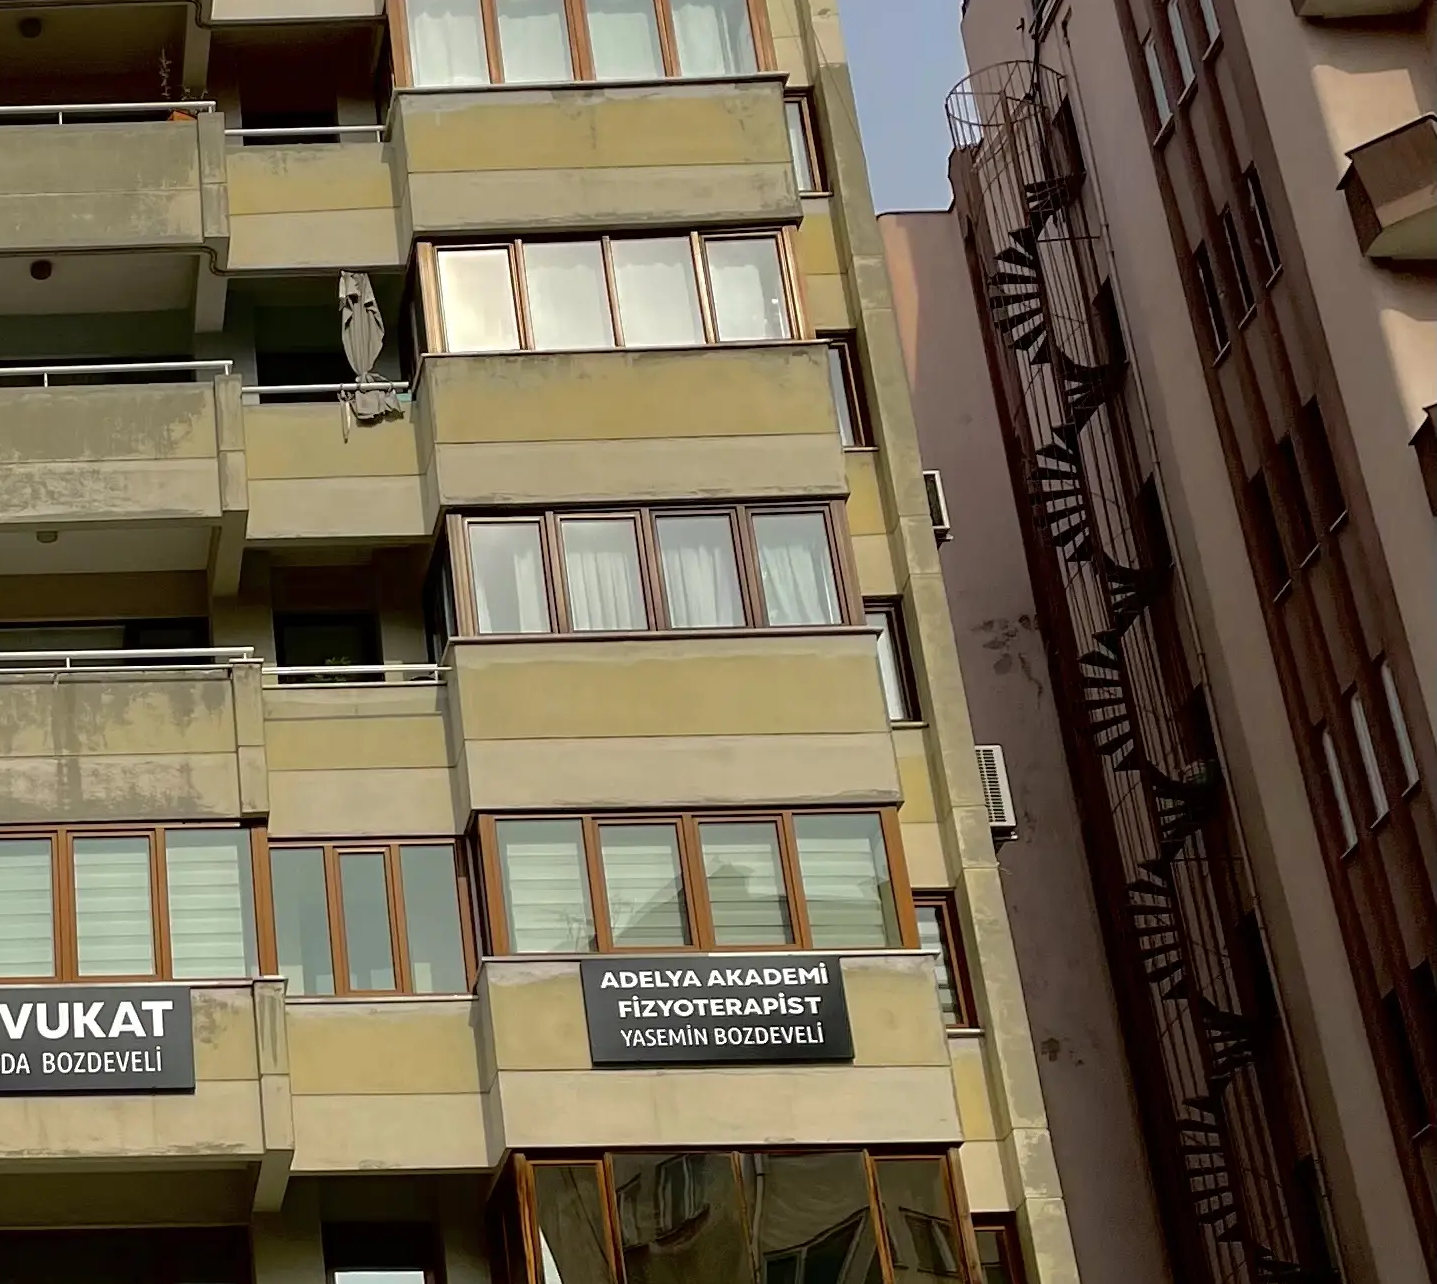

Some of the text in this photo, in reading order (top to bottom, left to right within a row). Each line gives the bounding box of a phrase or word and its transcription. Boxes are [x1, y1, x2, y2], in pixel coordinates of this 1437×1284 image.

[600, 962, 830, 990] ADELYA AKADEMİ
[617, 992, 822, 1018] FİZYOTERAPİST
[620, 1021, 825, 1047] YASEMİN BOZDEVELİ
[42, 1045, 163, 1074] BOZDEVELİ
